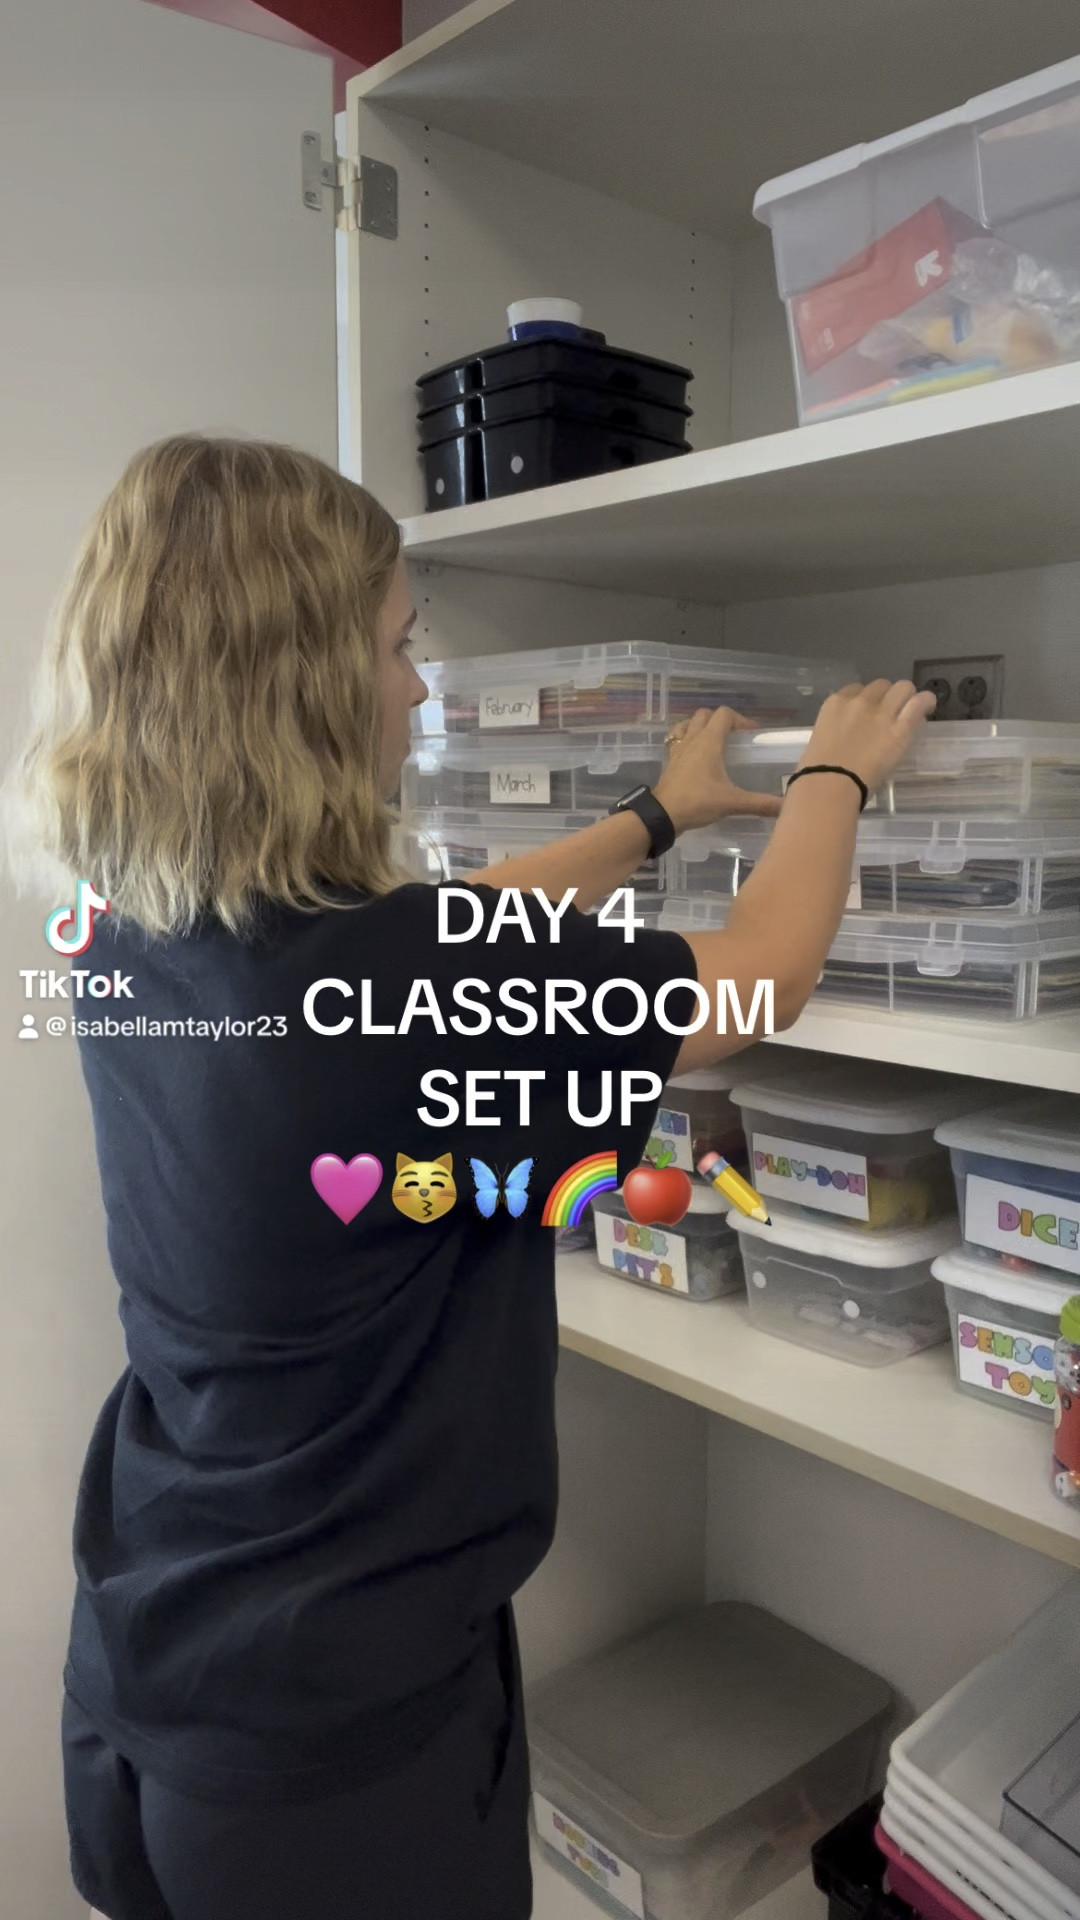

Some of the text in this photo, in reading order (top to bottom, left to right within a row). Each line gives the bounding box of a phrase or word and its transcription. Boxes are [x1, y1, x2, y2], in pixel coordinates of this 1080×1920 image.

[485, 696, 534, 716] February
[497, 773, 536, 793] March
[754, 1150, 866, 1196] PLAY-DOH
[998, 1201, 1079, 1250] DICE
[959, 1321, 1055, 1371] SENSO
[984, 1361, 1057, 1404] TOY
